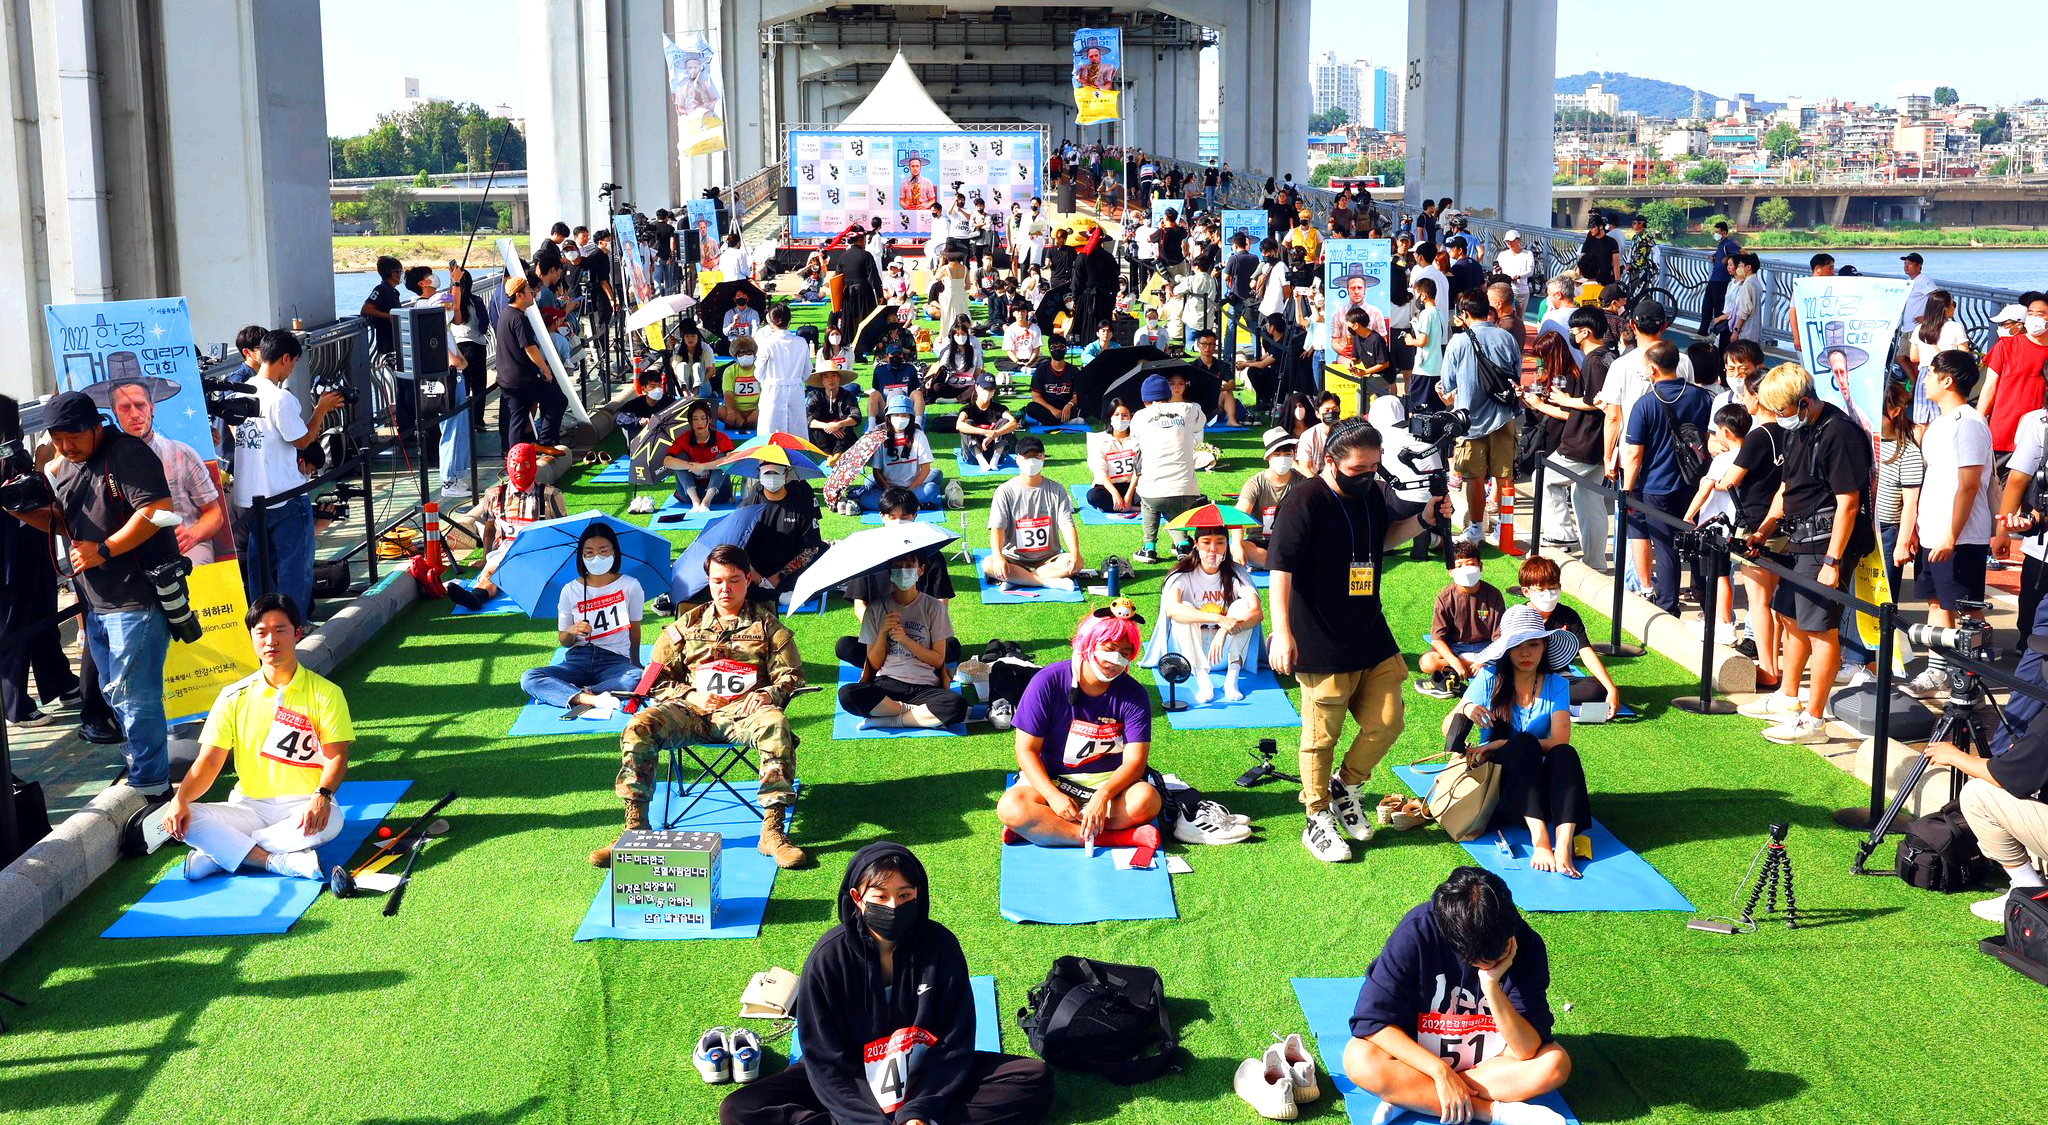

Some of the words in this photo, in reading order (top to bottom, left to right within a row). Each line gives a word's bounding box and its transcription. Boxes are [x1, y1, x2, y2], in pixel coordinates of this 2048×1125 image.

[1409, 59, 1421, 90] 26
[851, 140, 863, 156] 멍
[991, 140, 1003, 156] 멍
[802, 164, 815, 181] 멍
[827, 188, 839, 204] 멍
[912, 260, 919, 270] 2
[370, 290, 380, 300] 6
[60, 327, 91, 351] 2022
[90, 313, 145, 348] 한강
[1847, 332, 1874, 344] 대회
[141, 346, 190, 361] 때리기
[143, 361, 177, 376] 대회
[738, 383, 755, 394] 25
[1421, 446, 1438, 458] RONIN
[1114, 458, 1134, 475] 35
[108, 473, 118, 497] Canon
[1024, 528, 1047, 548] 39
[1350, 581, 1372, 591] STAFF
[202, 604, 234, 617] 허하라!
[594, 605, 620, 631] 41
[707, 673, 745, 694] 46
[276, 711, 295, 723] 2022
[276, 730, 316, 761] 49
[1076, 740, 1116, 759] 47
[616, 853, 632, 863] 나는
[617, 883, 641, 893] 이것은
[644, 882, 676, 892] 직장에서
[1422, 1019, 1446, 1031] 2022
[1446, 1020, 1460, 1028] 한강
[867, 1042, 889, 1058] 2022
[1440, 1034, 1485, 1070] 51
